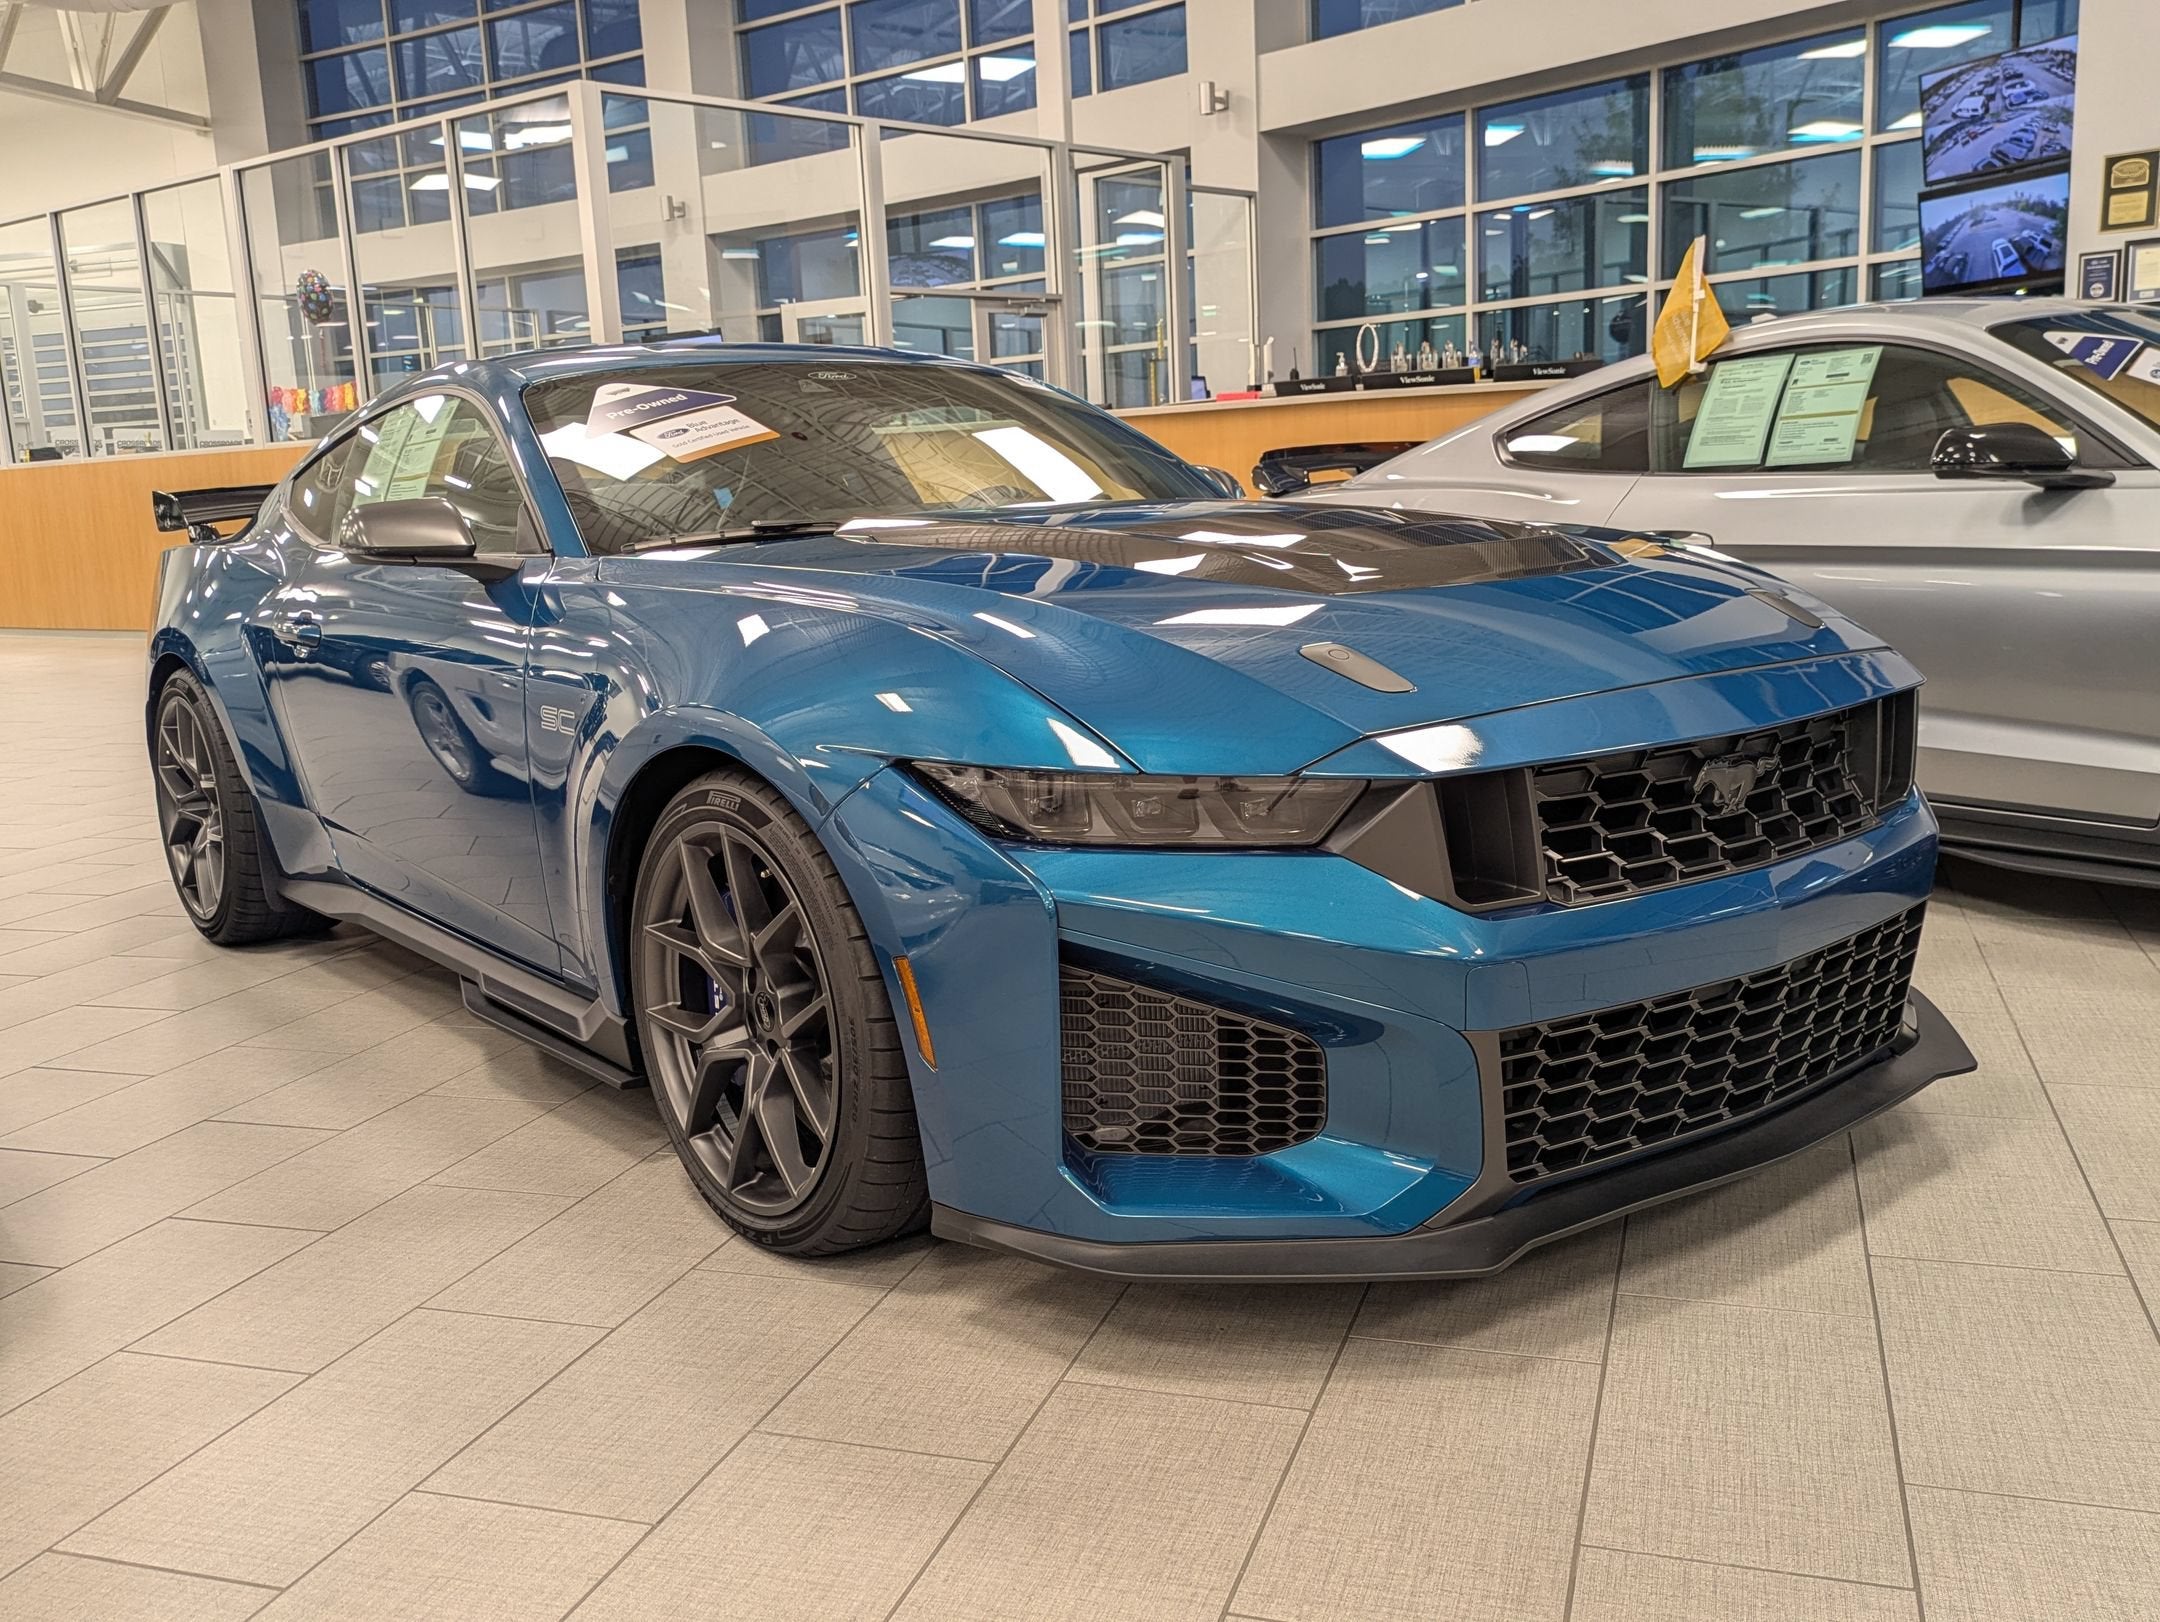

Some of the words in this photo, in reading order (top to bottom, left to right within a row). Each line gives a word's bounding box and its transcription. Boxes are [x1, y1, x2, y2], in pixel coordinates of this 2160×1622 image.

[1533, 367, 1566, 376] ViewSonic
[1400, 375, 1435, 384] ViewSonic
[606, 394, 688, 420] Pre-Owned
[706, 790, 741, 812] PIRELLI
